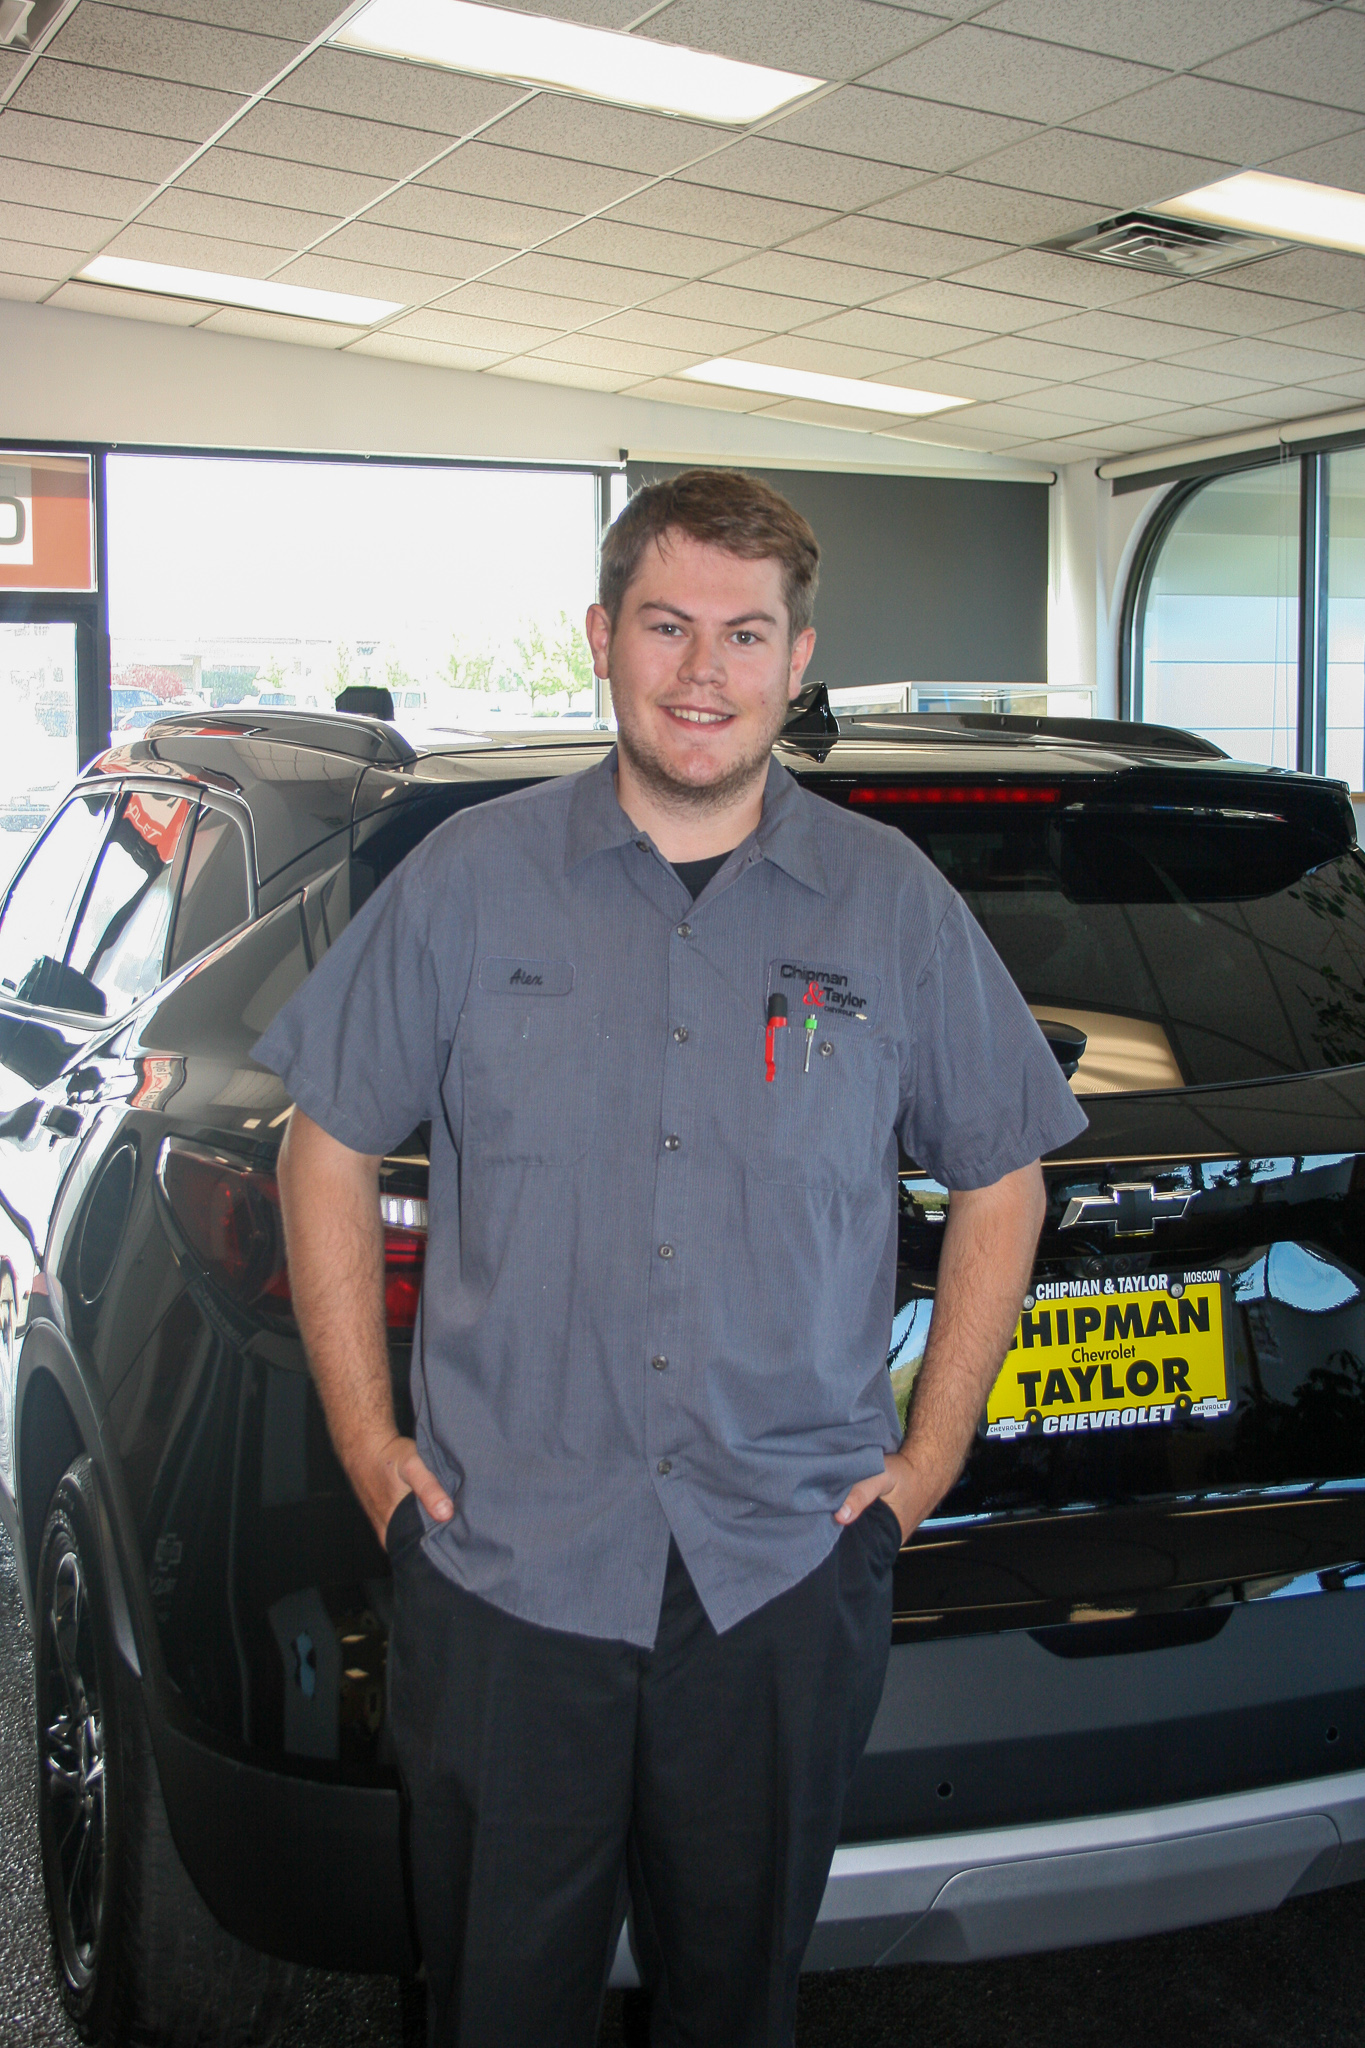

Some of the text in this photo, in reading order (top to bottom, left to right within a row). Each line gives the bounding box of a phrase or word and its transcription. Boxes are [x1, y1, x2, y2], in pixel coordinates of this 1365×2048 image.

[509, 968, 543, 985] Alex
[780, 964, 848, 987] Chipman
[802, 981, 867, 1009] & Taylor
[1035, 1270, 1220, 1300] CHIPMAN & TAYLOR MOSCOW
[1011, 1297, 1210, 1349] HIPMAN
[1071, 1344, 1136, 1363] Chevrolet
[1017, 1357, 1192, 1408] TAYLOR
[1042, 1404, 1175, 1434] CHEVROLET
[1193, 1403, 1227, 1411] CHEVROLET
[989, 1424, 1025, 1433] CHEVROLET
